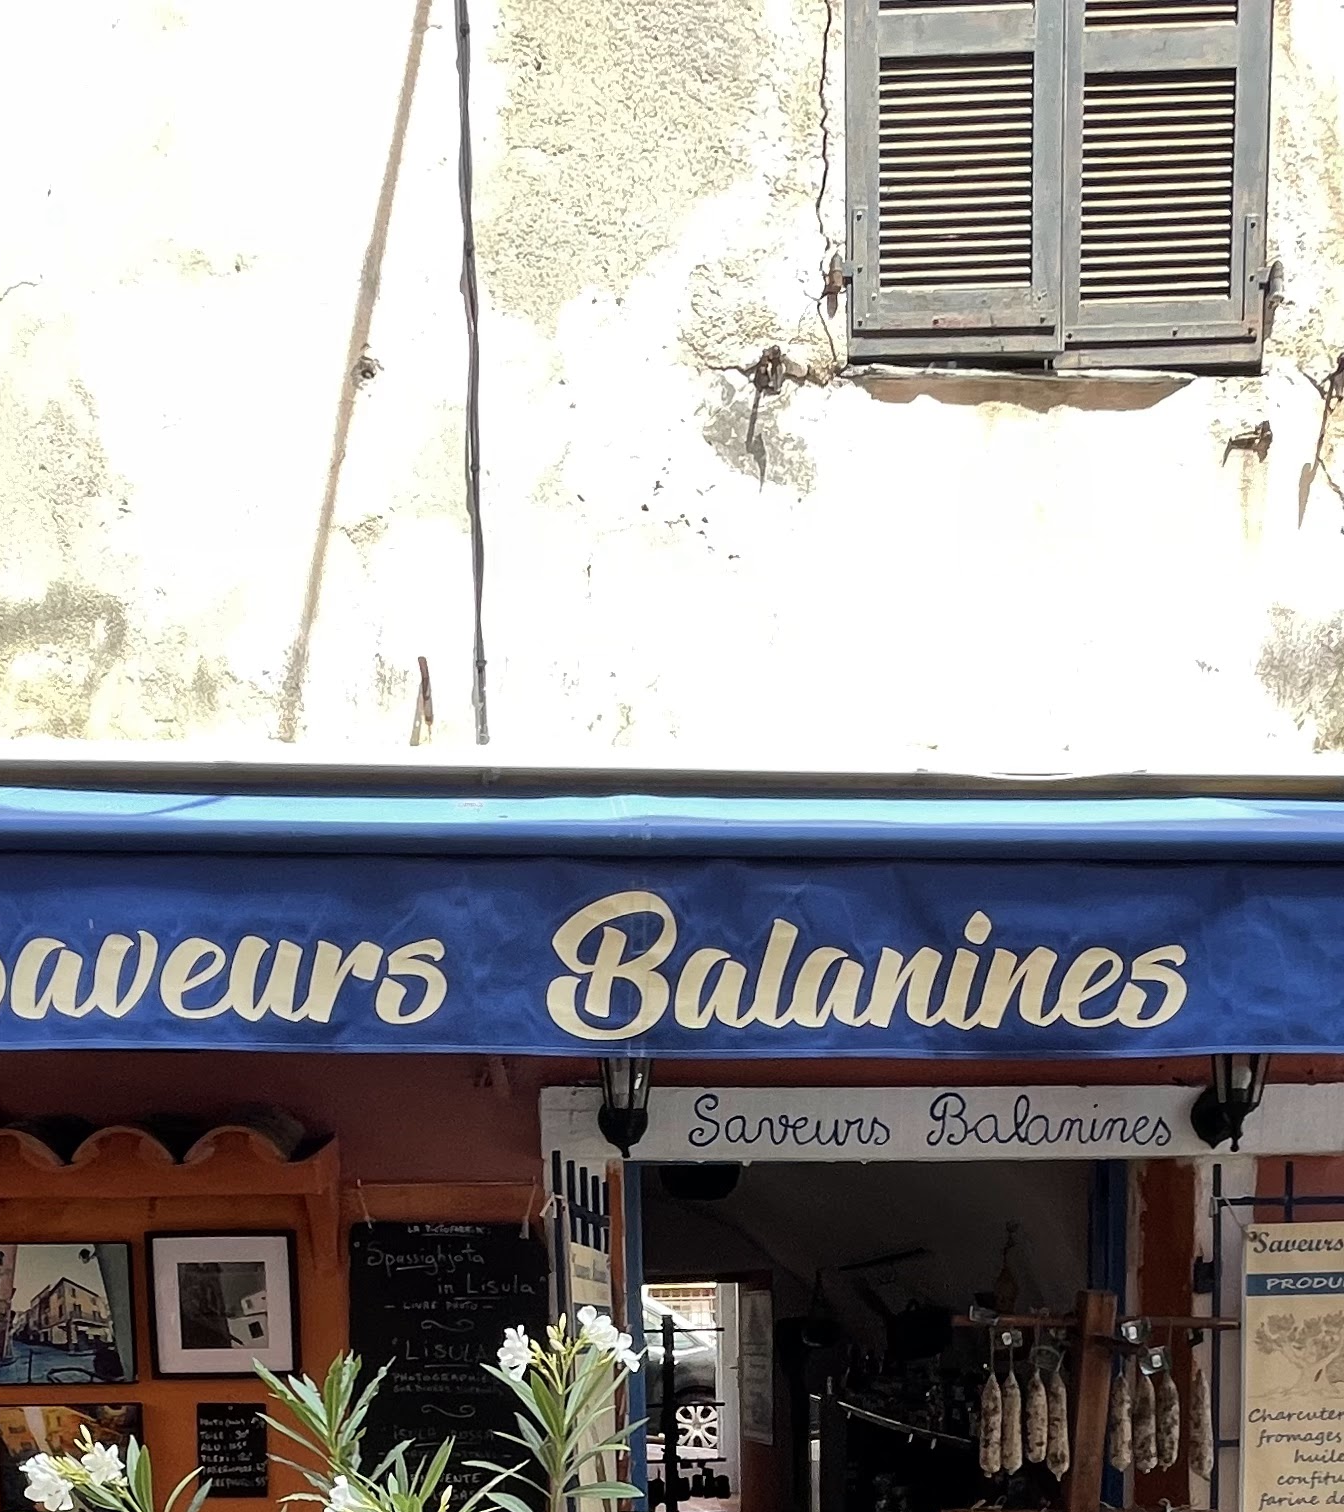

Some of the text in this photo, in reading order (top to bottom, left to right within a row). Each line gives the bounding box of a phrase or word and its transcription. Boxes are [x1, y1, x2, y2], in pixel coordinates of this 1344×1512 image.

[545, 889, 1188, 1042] Balanines
[687, 1091, 1173, 1149] Saveurs Balanines
[1252, 1230, 1344, 1254] Saveurs
[437, 1277, 455, 1294] in
[1256, 1428, 1343, 1448] fromages
[1258, 1492, 1318, 1512] farine
